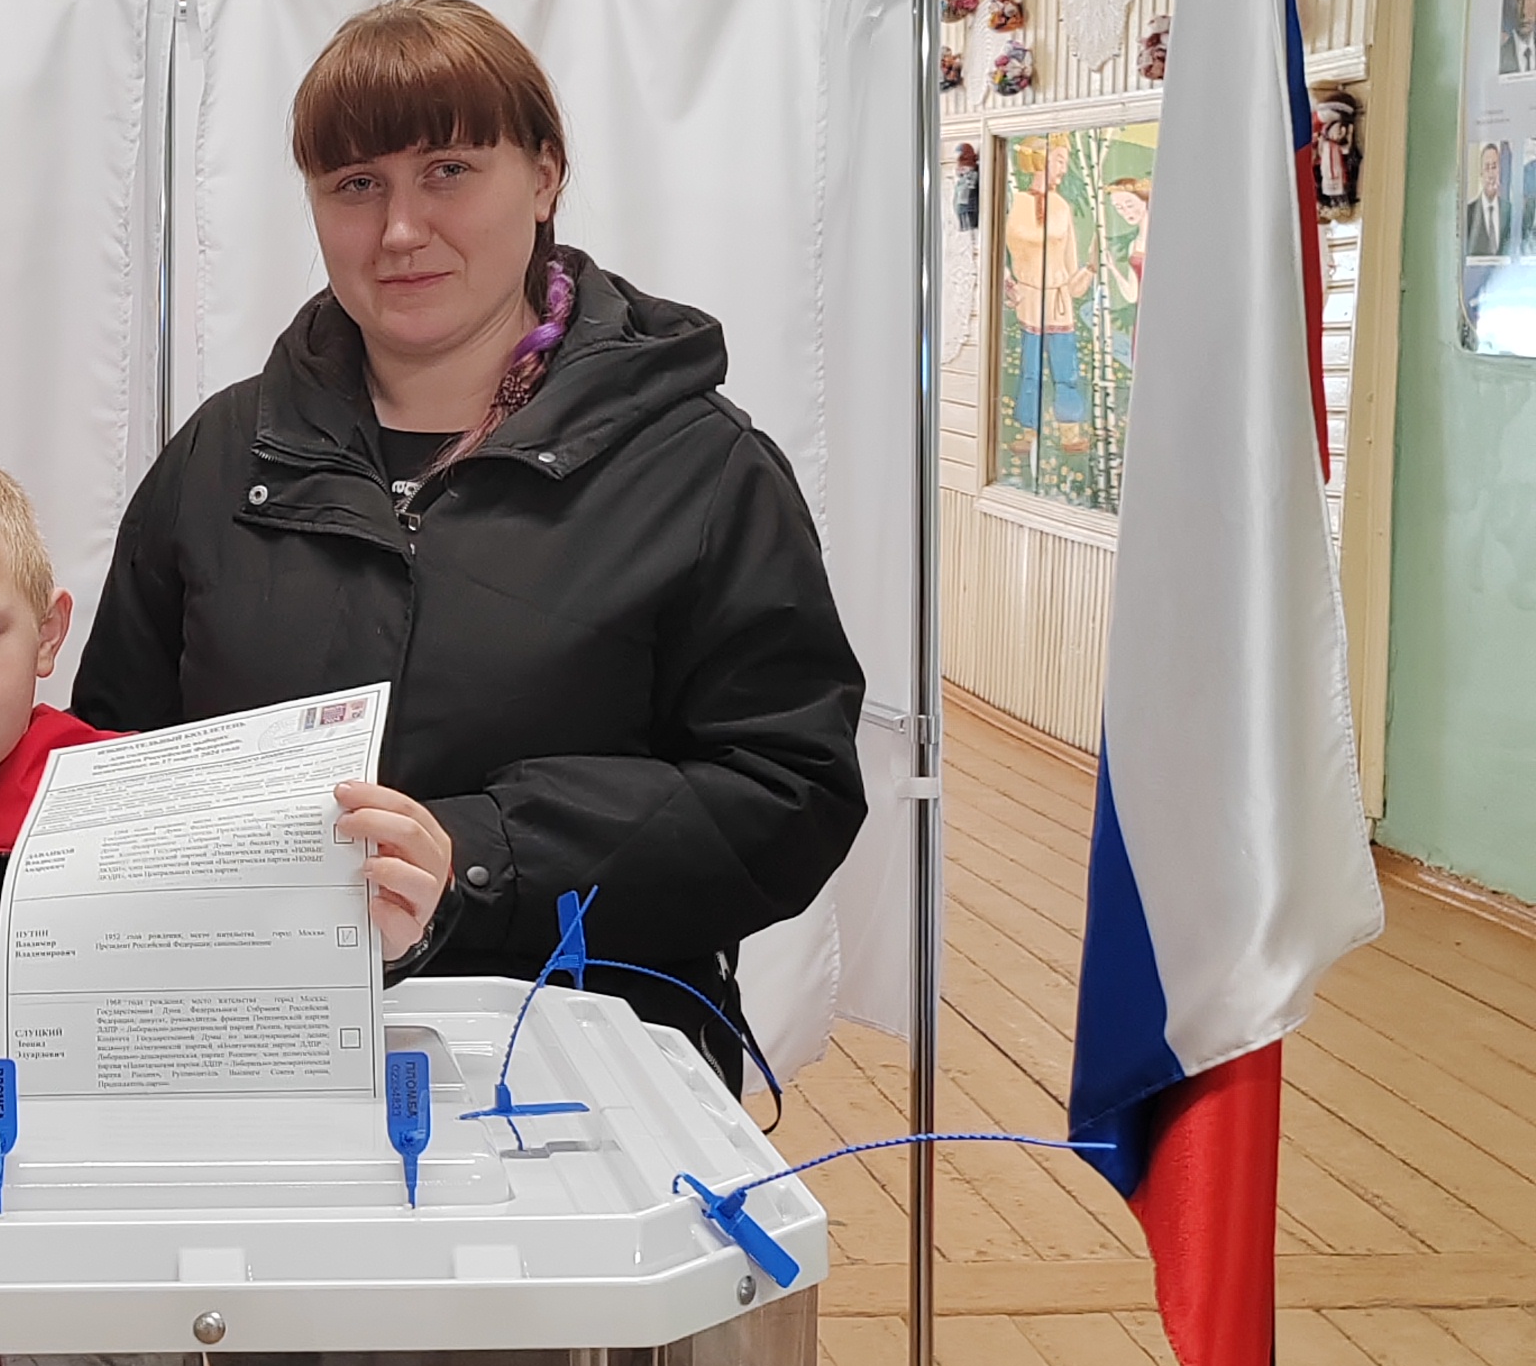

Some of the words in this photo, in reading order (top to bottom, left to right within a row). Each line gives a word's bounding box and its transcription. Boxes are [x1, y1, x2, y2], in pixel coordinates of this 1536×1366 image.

[15, 929, 48, 938] ПУТИН
[14, 1028, 62, 1037] СЛУЦКИЙ
[406, 1061, 418, 1119] ПЛОМБА
